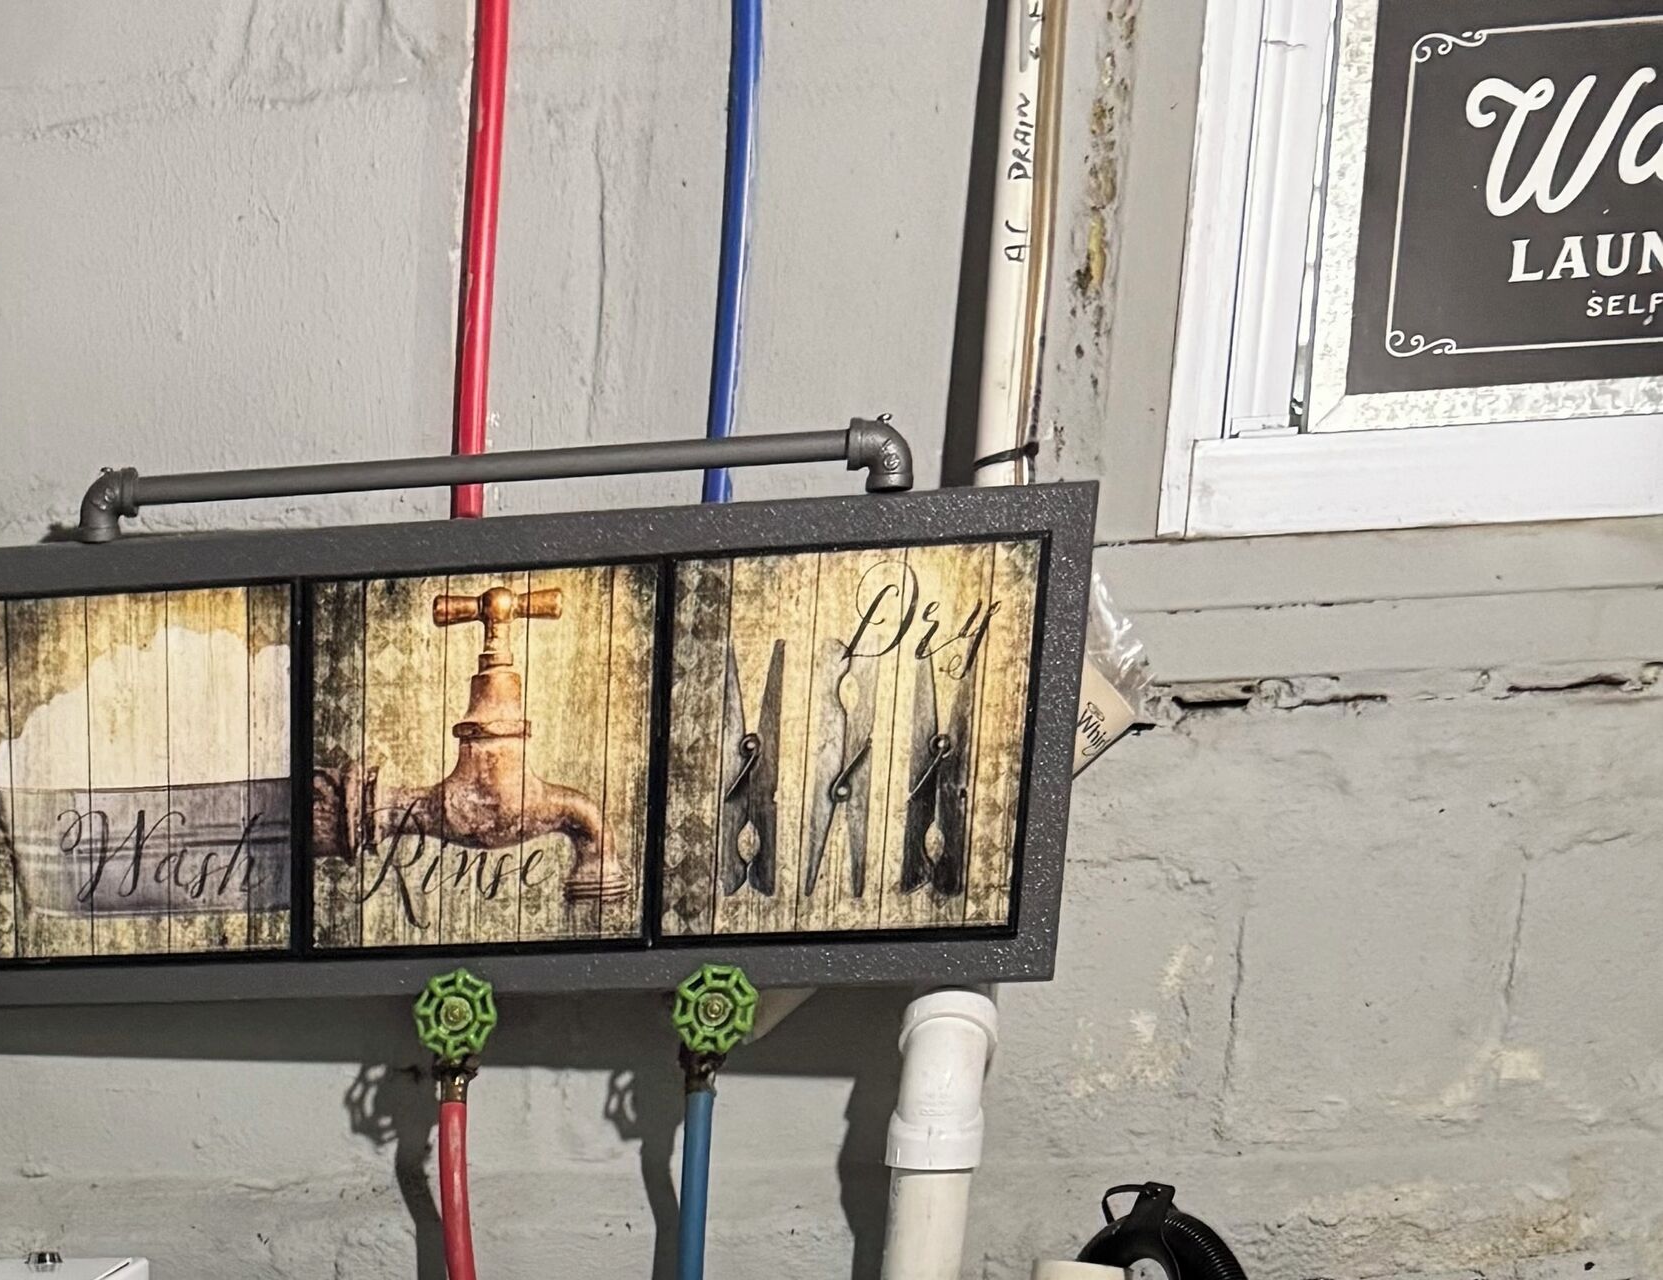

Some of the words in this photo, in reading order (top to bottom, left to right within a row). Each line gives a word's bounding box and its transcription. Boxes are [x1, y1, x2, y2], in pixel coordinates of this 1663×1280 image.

[1008, 92, 1034, 181] DRAIN
[840, 559, 1003, 681] Dry
[57, 808, 268, 903] Wash
[363, 797, 560, 930] Rinse
